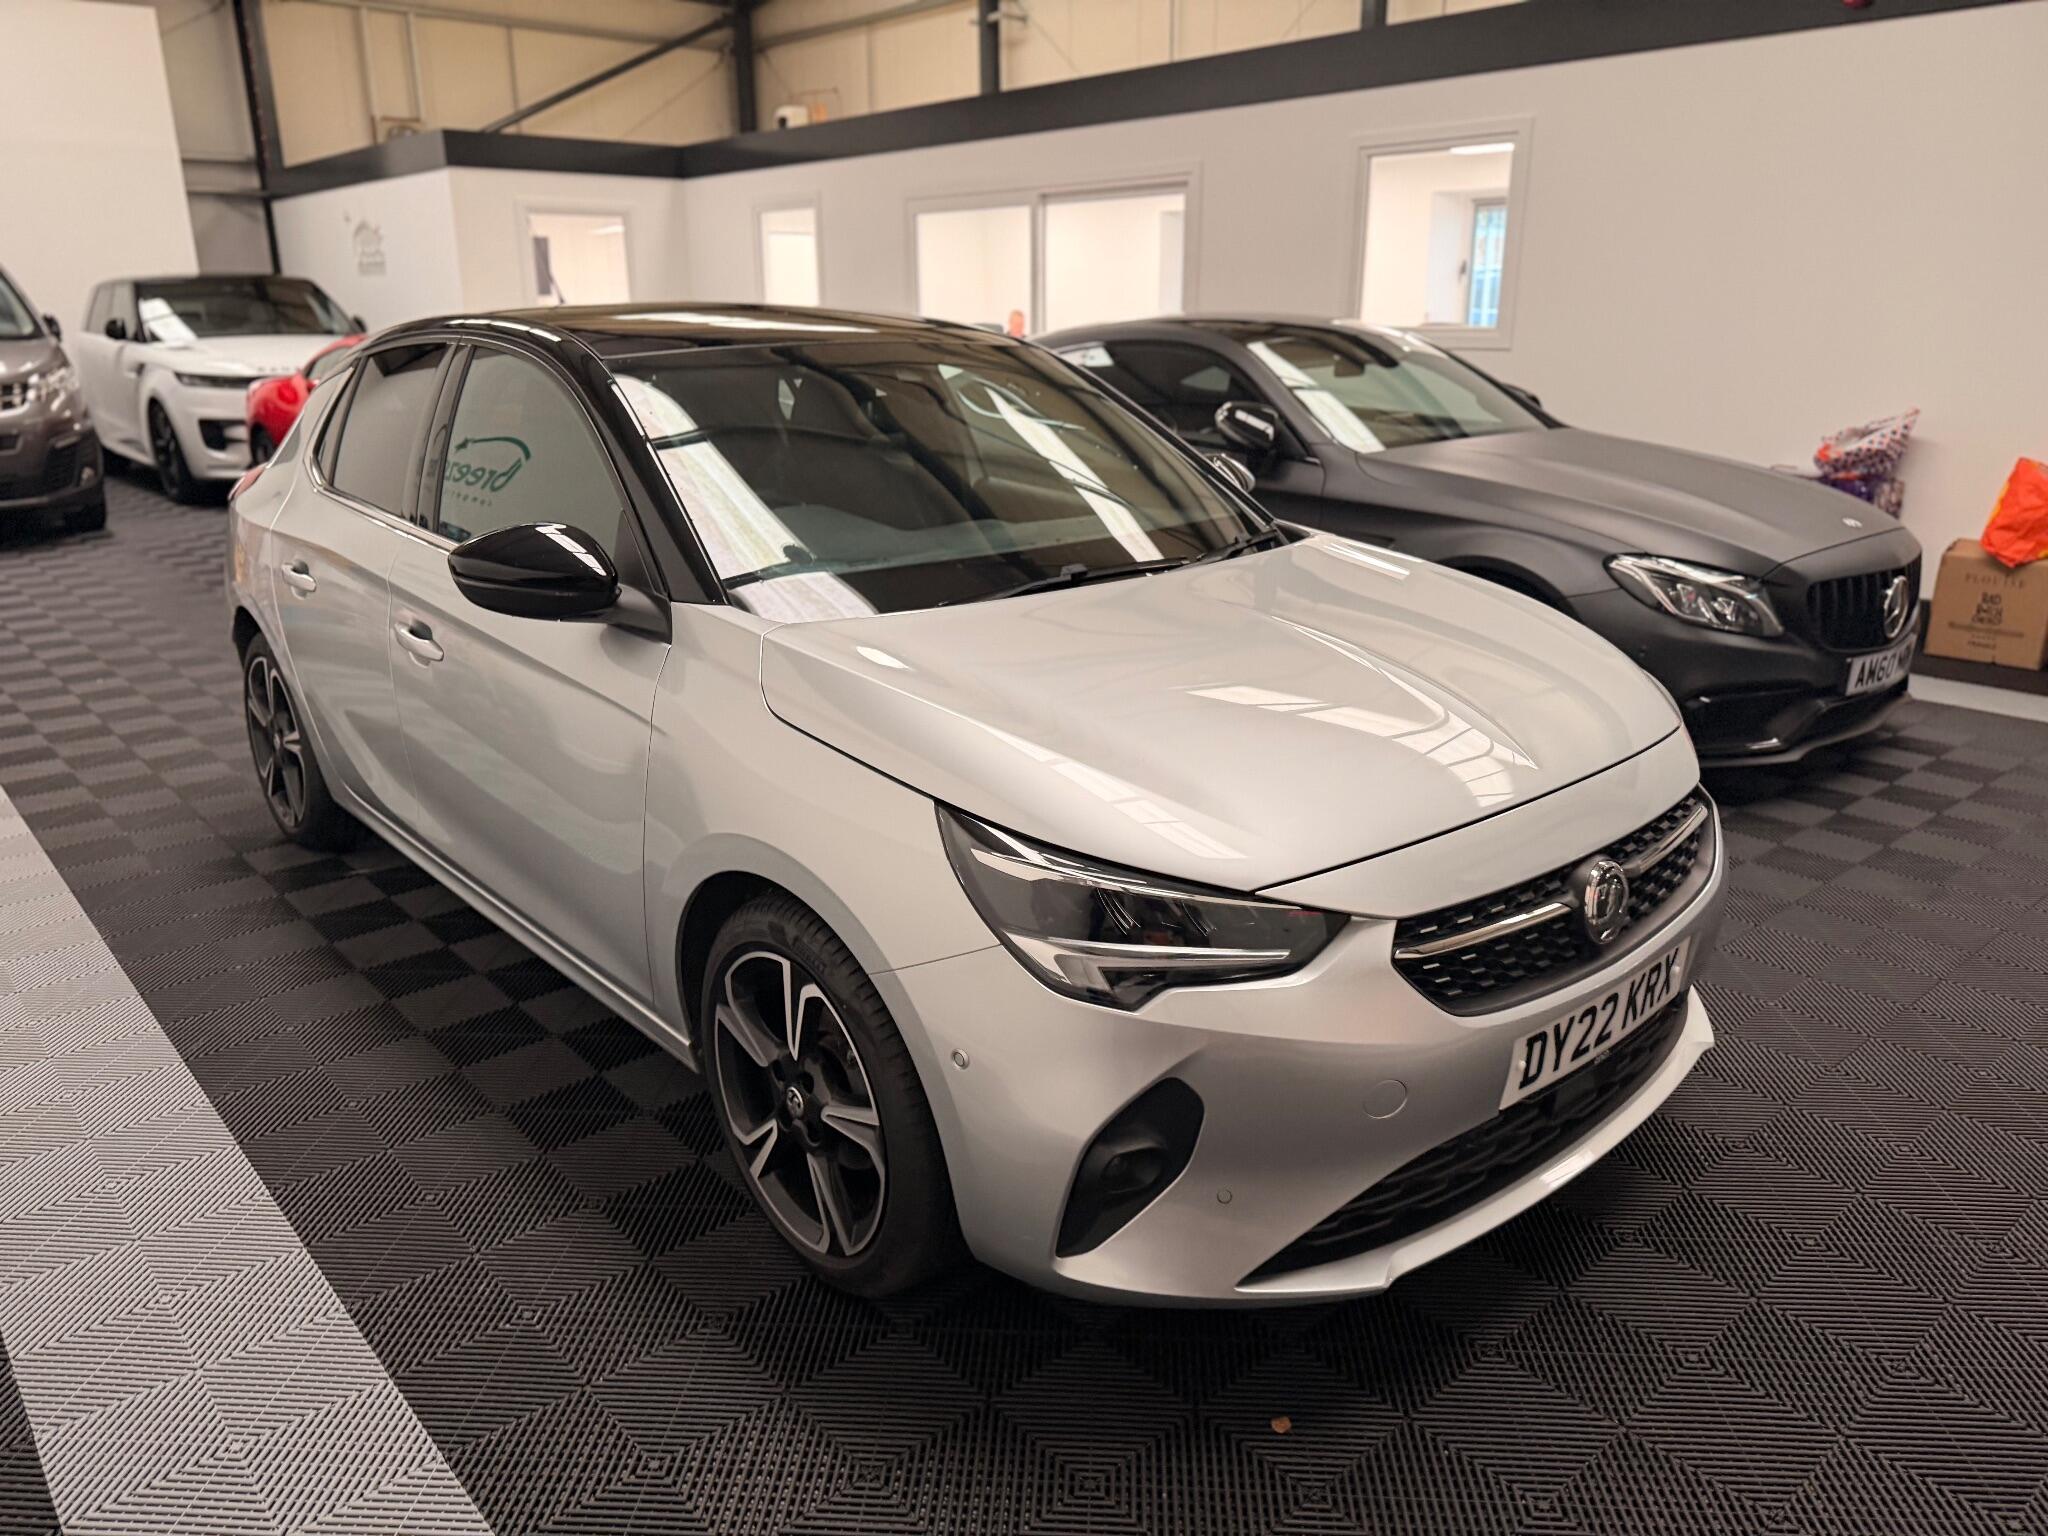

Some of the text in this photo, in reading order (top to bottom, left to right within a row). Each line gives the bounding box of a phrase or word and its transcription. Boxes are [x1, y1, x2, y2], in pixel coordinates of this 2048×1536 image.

[1854, 652, 1898, 689] AM60
[1518, 947, 1679, 1090] DY22 KRX
